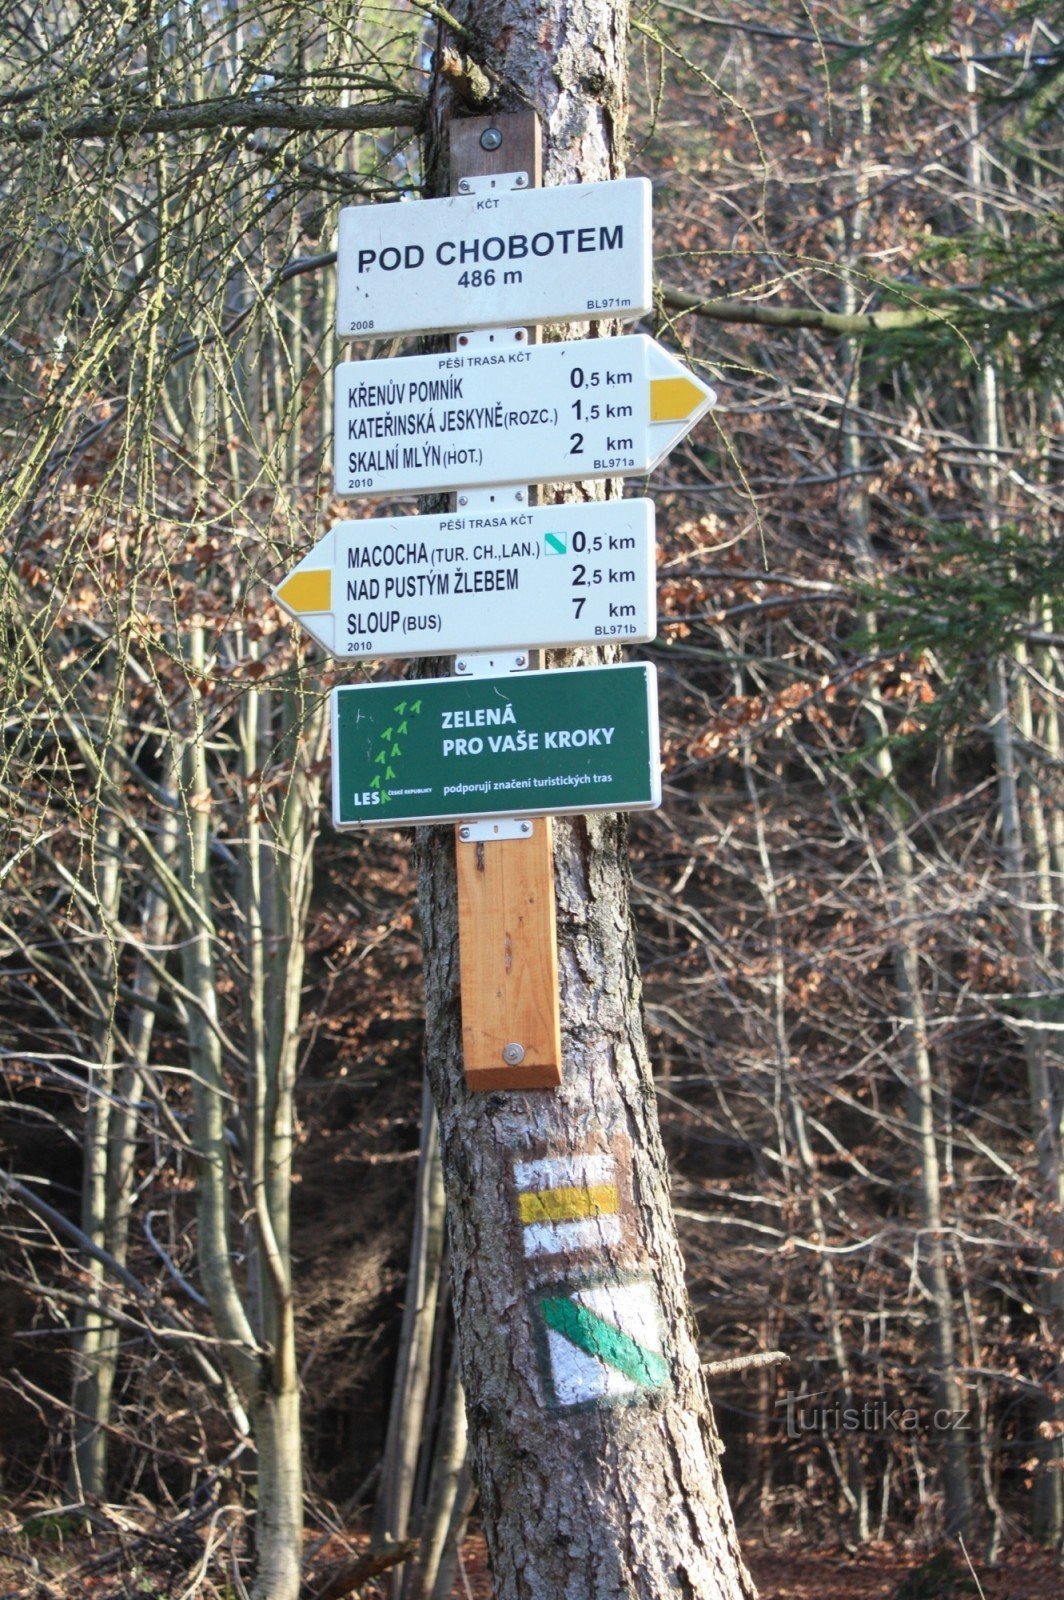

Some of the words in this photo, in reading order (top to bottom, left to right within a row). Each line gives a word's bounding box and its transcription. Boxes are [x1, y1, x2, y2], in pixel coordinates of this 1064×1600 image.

[477, 199, 499, 210] KČT
[358, 245, 424, 273] POD
[436, 225, 624, 266] CHOBOTEM
[458, 269, 496, 289] 486
[504, 269, 523, 285] m
[587, 298, 631, 310] BL971m
[350, 320, 374, 331] 2008
[438, 357, 464, 369] PĚŠÍ
[467, 355, 505, 368] TRASA
[509, 351, 531, 363] KČT
[348, 379, 405, 408] KŘENŮV
[409, 374, 463, 403] POMNÍK
[570, 367, 600, 389] 0,5
[606, 371, 633, 385] km
[348, 407, 436, 440] KATEŘINSKÁ
[571, 399, 600, 423] 1,5
[606, 404, 633, 418] km
[348, 444, 399, 473] SKALNÍ
[570, 432, 584, 455] 2
[607, 437, 633, 451] km
[593, 457, 635, 469] BL971a
[348, 478, 373, 489] 2010
[439, 519, 466, 531] PĚŠÍ
[469, 517, 507, 529] TRASA
[510, 514, 534, 526] KČT
[572, 530, 602, 554] 0,5
[608, 535, 635, 550] km
[347, 578, 380, 601] NAD
[385, 569, 449, 599] PUSTÝM
[453, 567, 519, 594] ŽLEBEM
[571, 564, 602, 587] 2,5
[608, 568, 635, 583] km
[572, 597, 586, 619] 7
[609, 603, 636, 617] km
[594, 624, 637, 636] BL971b
[347, 641, 372, 652] 2010
[441, 703, 517, 729] ZELENÁ
[443, 737, 483, 757] PRO
[488, 729, 539, 753] VAŠE
[544, 727, 615, 749] KROKY
[443, 780, 491, 796] podporují
[493, 778, 531, 790] značení
[533, 774, 591, 787] turistických
[593, 773, 613, 782] tras
